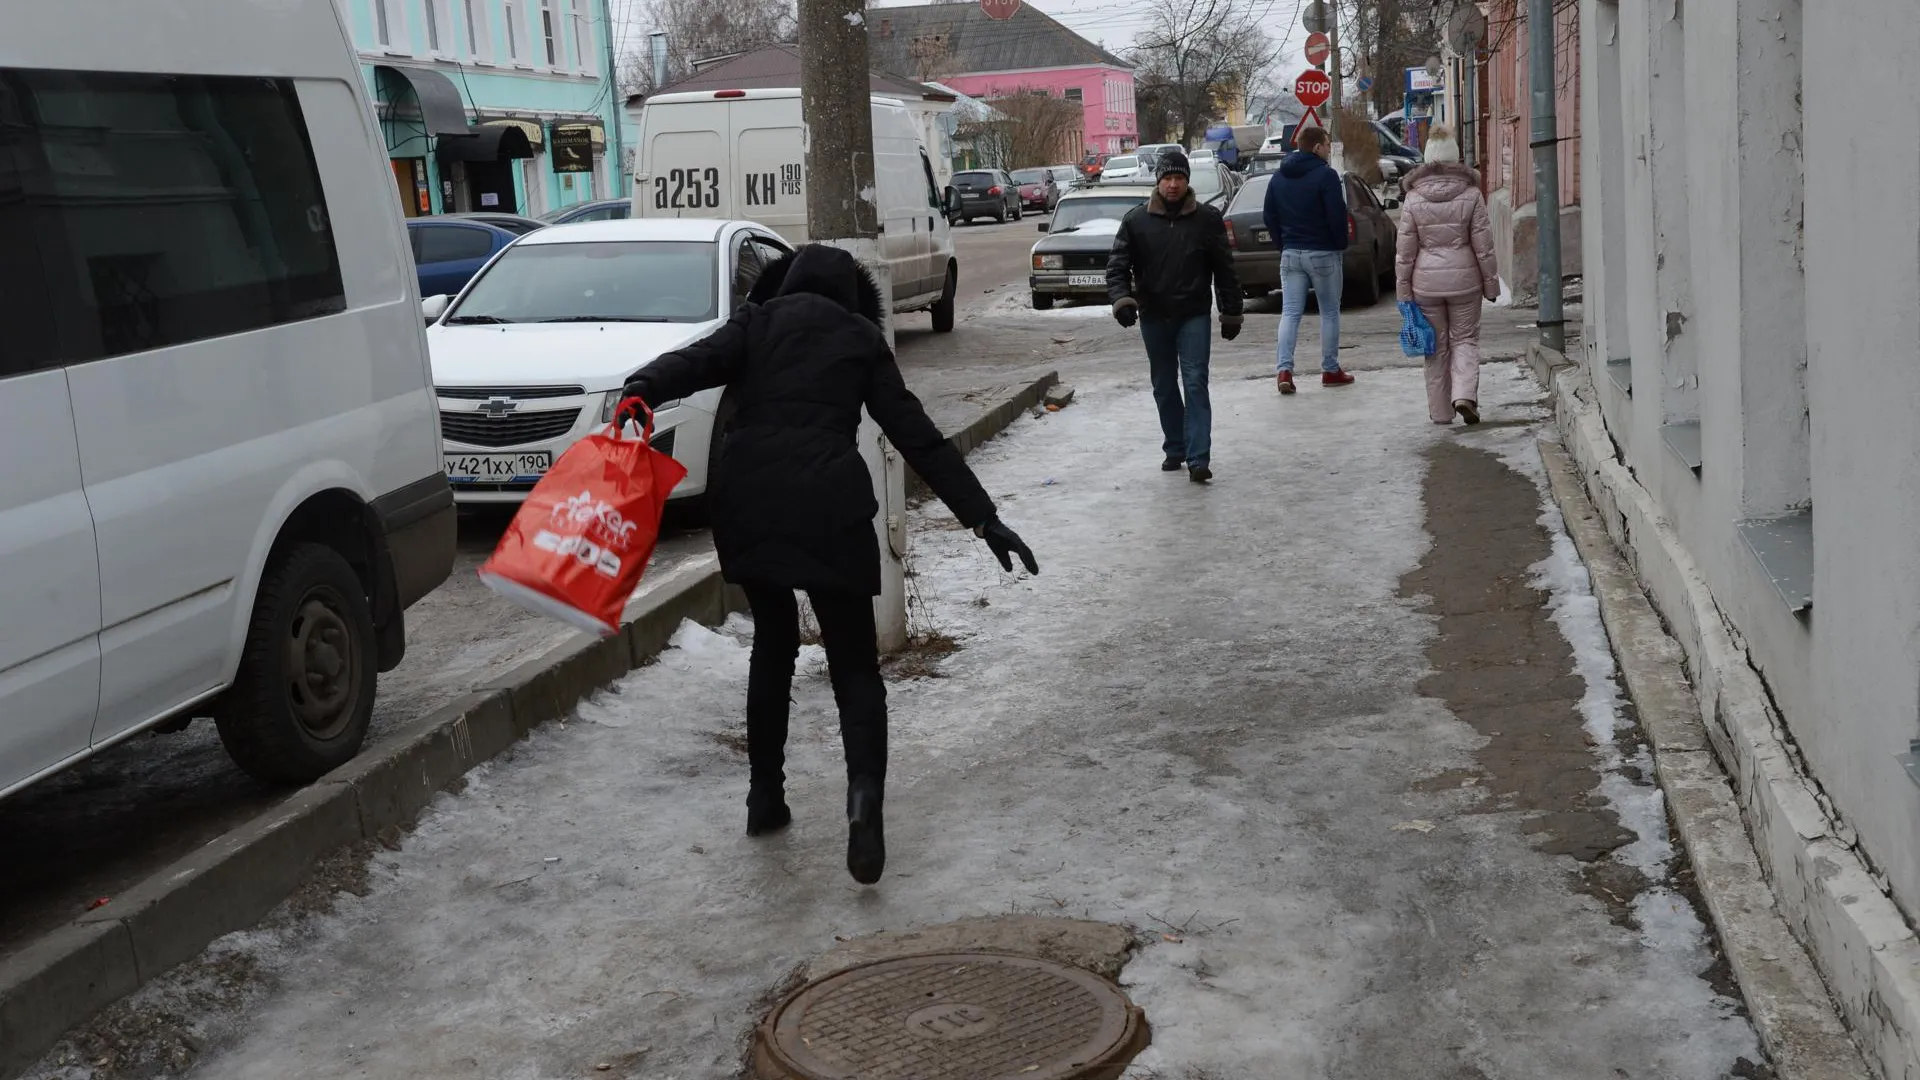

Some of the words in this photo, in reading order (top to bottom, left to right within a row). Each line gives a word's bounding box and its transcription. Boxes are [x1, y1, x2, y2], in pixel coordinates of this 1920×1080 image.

[1296, 81, 1330, 94] STOP
[655, 167, 720, 209] а253
[780, 163, 801, 180] 190
[782, 181, 801, 195] rus
[518, 455, 544, 469] 190
